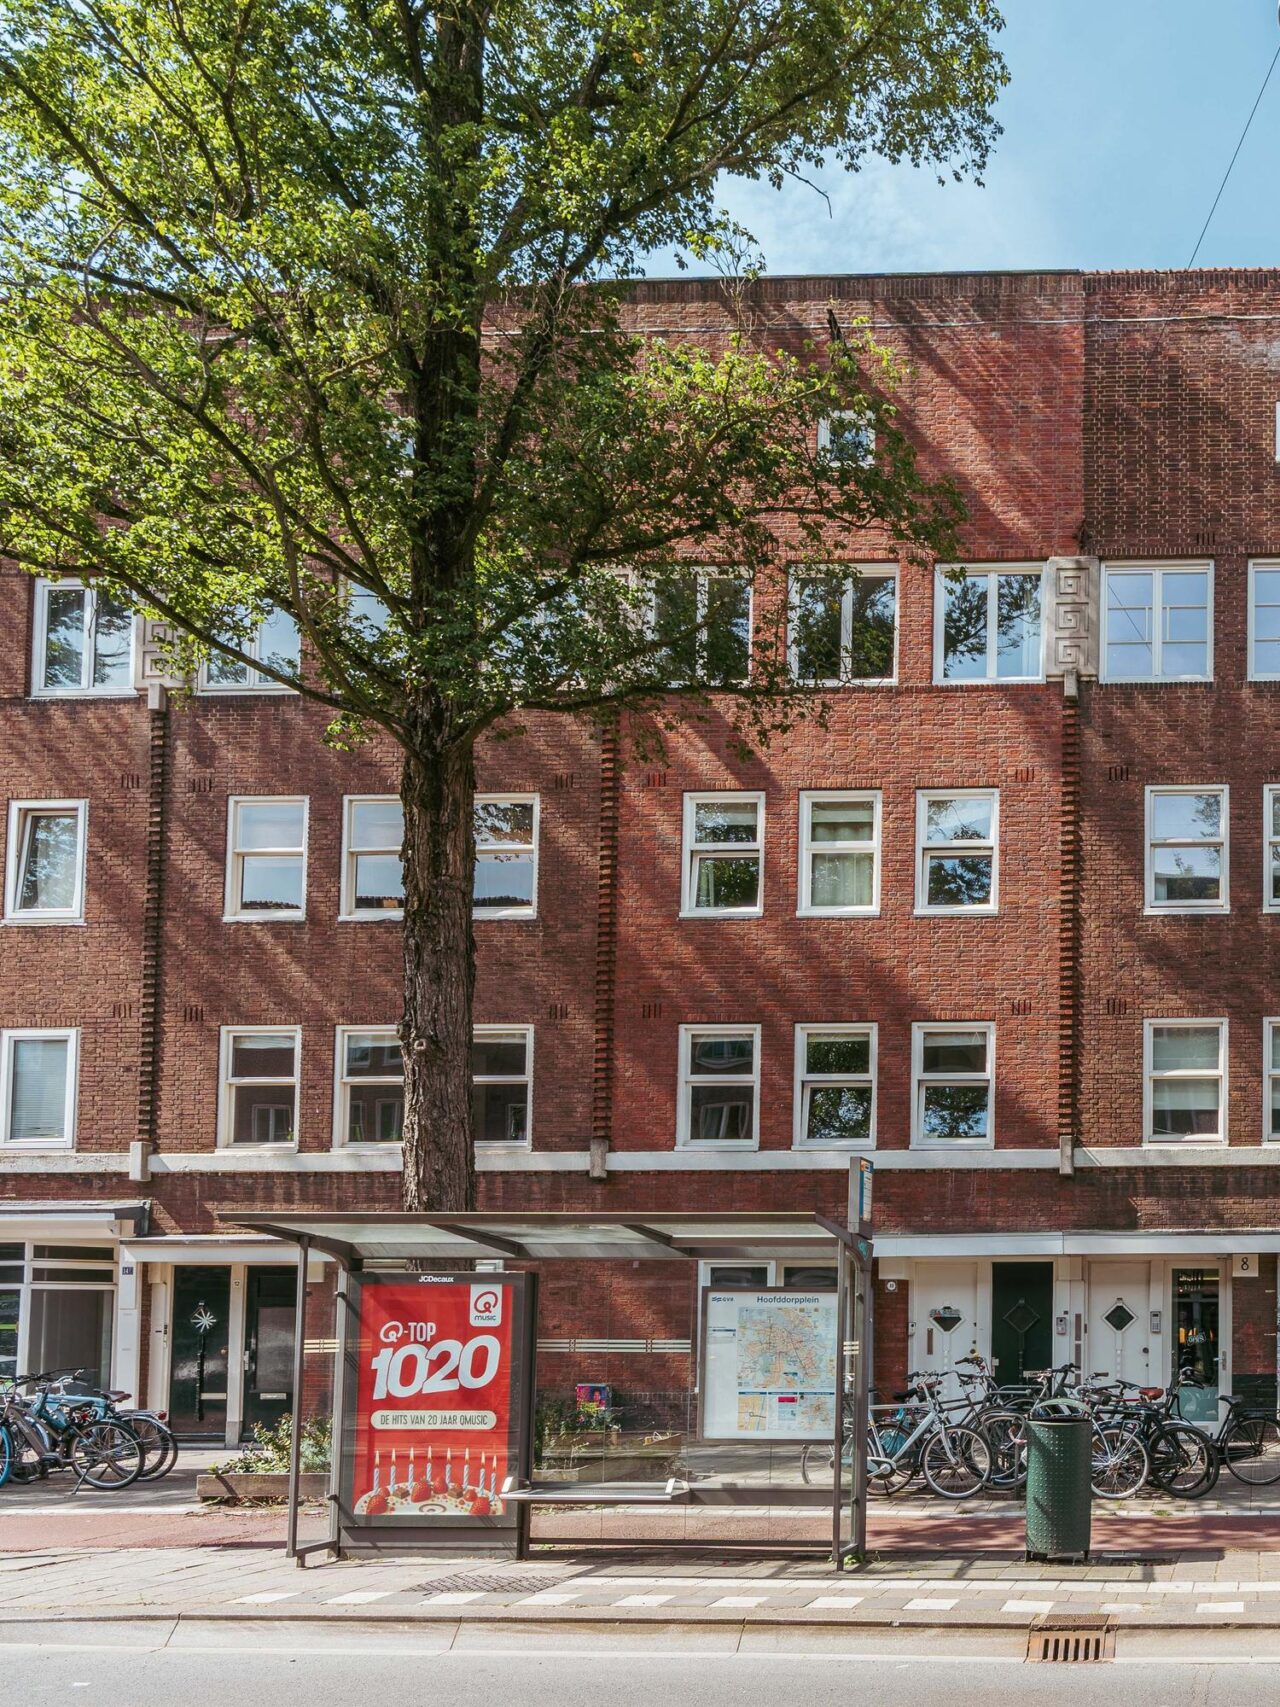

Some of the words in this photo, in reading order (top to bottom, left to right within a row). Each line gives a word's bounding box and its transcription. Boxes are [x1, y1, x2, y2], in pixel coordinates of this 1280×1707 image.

[1241, 1257, 1249, 1270] 8
[418, 1275, 454, 1283] JCDecaux
[757, 1296, 819, 1304] Hoofddorpplein
[371, 1335, 500, 1400] 1020
[380, 1415, 390, 1425] DE
[392, 1415, 408, 1425] HITS
[411, 1415, 425, 1424] VAN
[428, 1415, 437, 1425] 20
[440, 1415, 457, 1425] JAAR
[459, 1415, 488, 1426] QMUSIC
